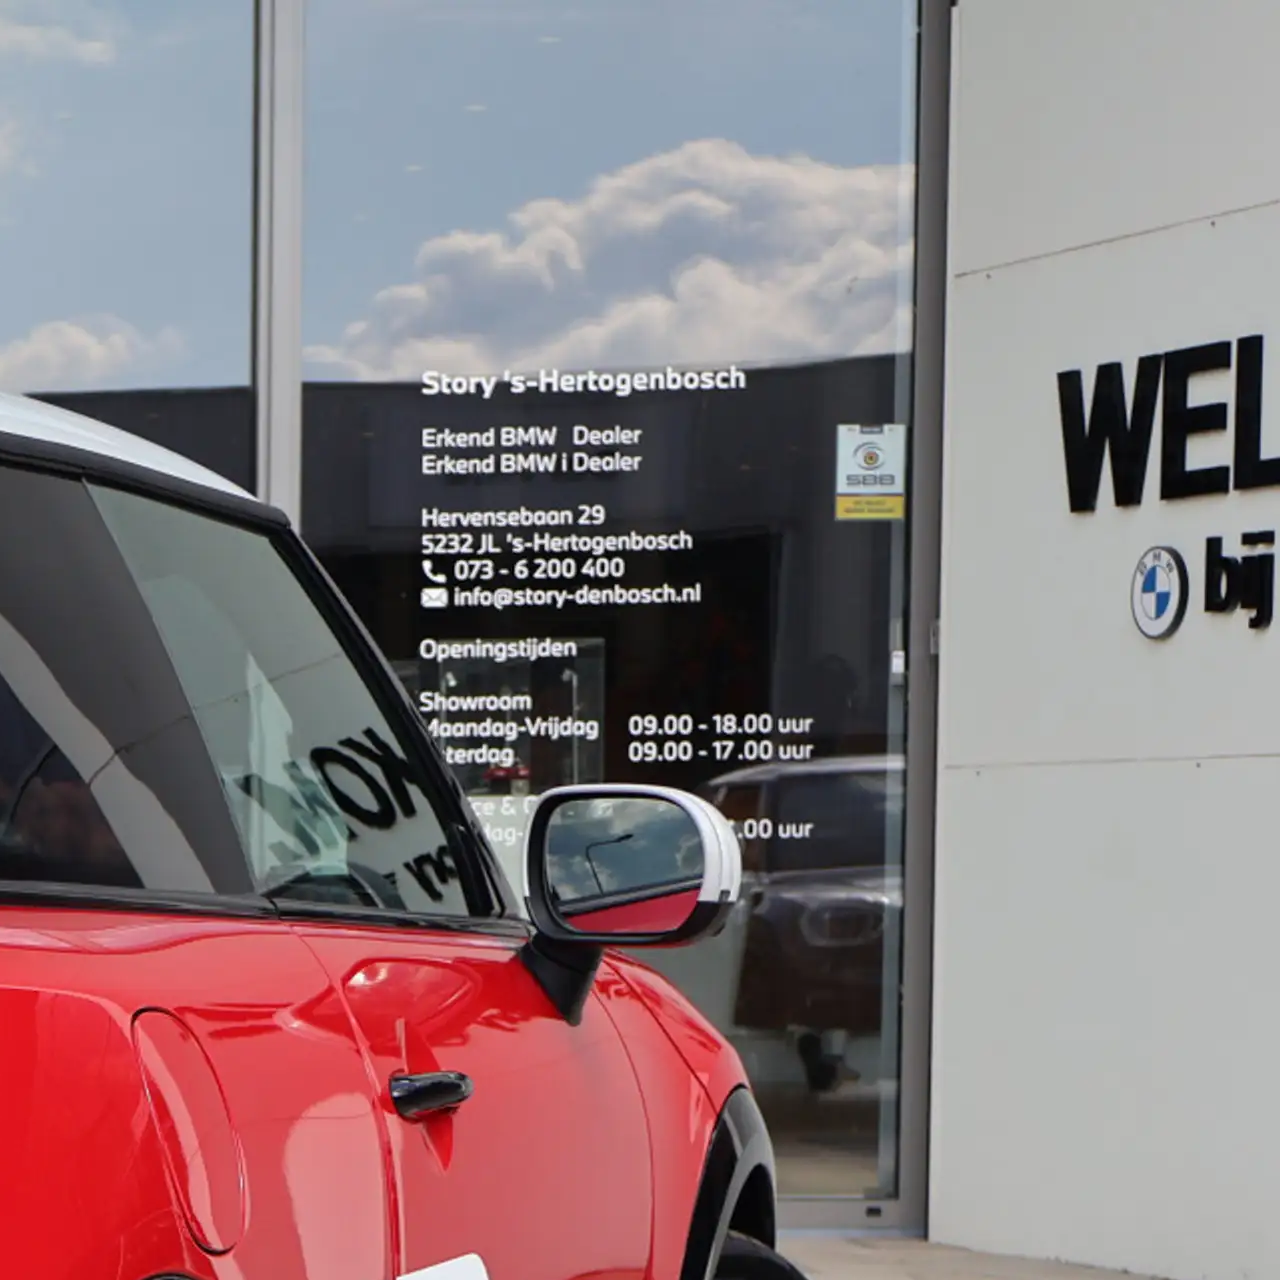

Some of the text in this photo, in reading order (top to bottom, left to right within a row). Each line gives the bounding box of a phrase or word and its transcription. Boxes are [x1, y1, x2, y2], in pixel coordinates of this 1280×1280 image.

[421, 365, 746, 398] Story 's-Hertogenbosch
[421, 425, 642, 448] Erkend BMW Dealer
[421, 452, 642, 474] Erkend BMW i Dealer
[421, 505, 606, 527] Hervensebaan 29
[421, 530, 693, 555] 5232 JL 's-Hertogenbosch
[454, 560, 494, 580] 073
[514, 559, 529, 579] 6
[532, 558, 576, 579] 200
[580, 558, 625, 578] 400
[1204, 530, 1276, 628] bij
[453, 582, 702, 610] info@story-denbosch.nl
[419, 637, 578, 662] Openingstijden
[419, 691, 532, 712] Showroom
[628, 715, 693, 735] 09.00
[712, 713, 773, 734] 18.00
[777, 717, 814, 734] uur
[443, 744, 514, 767] terdag
[628, 741, 693, 762] 09.00
[777, 743, 814, 760] uur
[777, 823, 814, 839] uur
